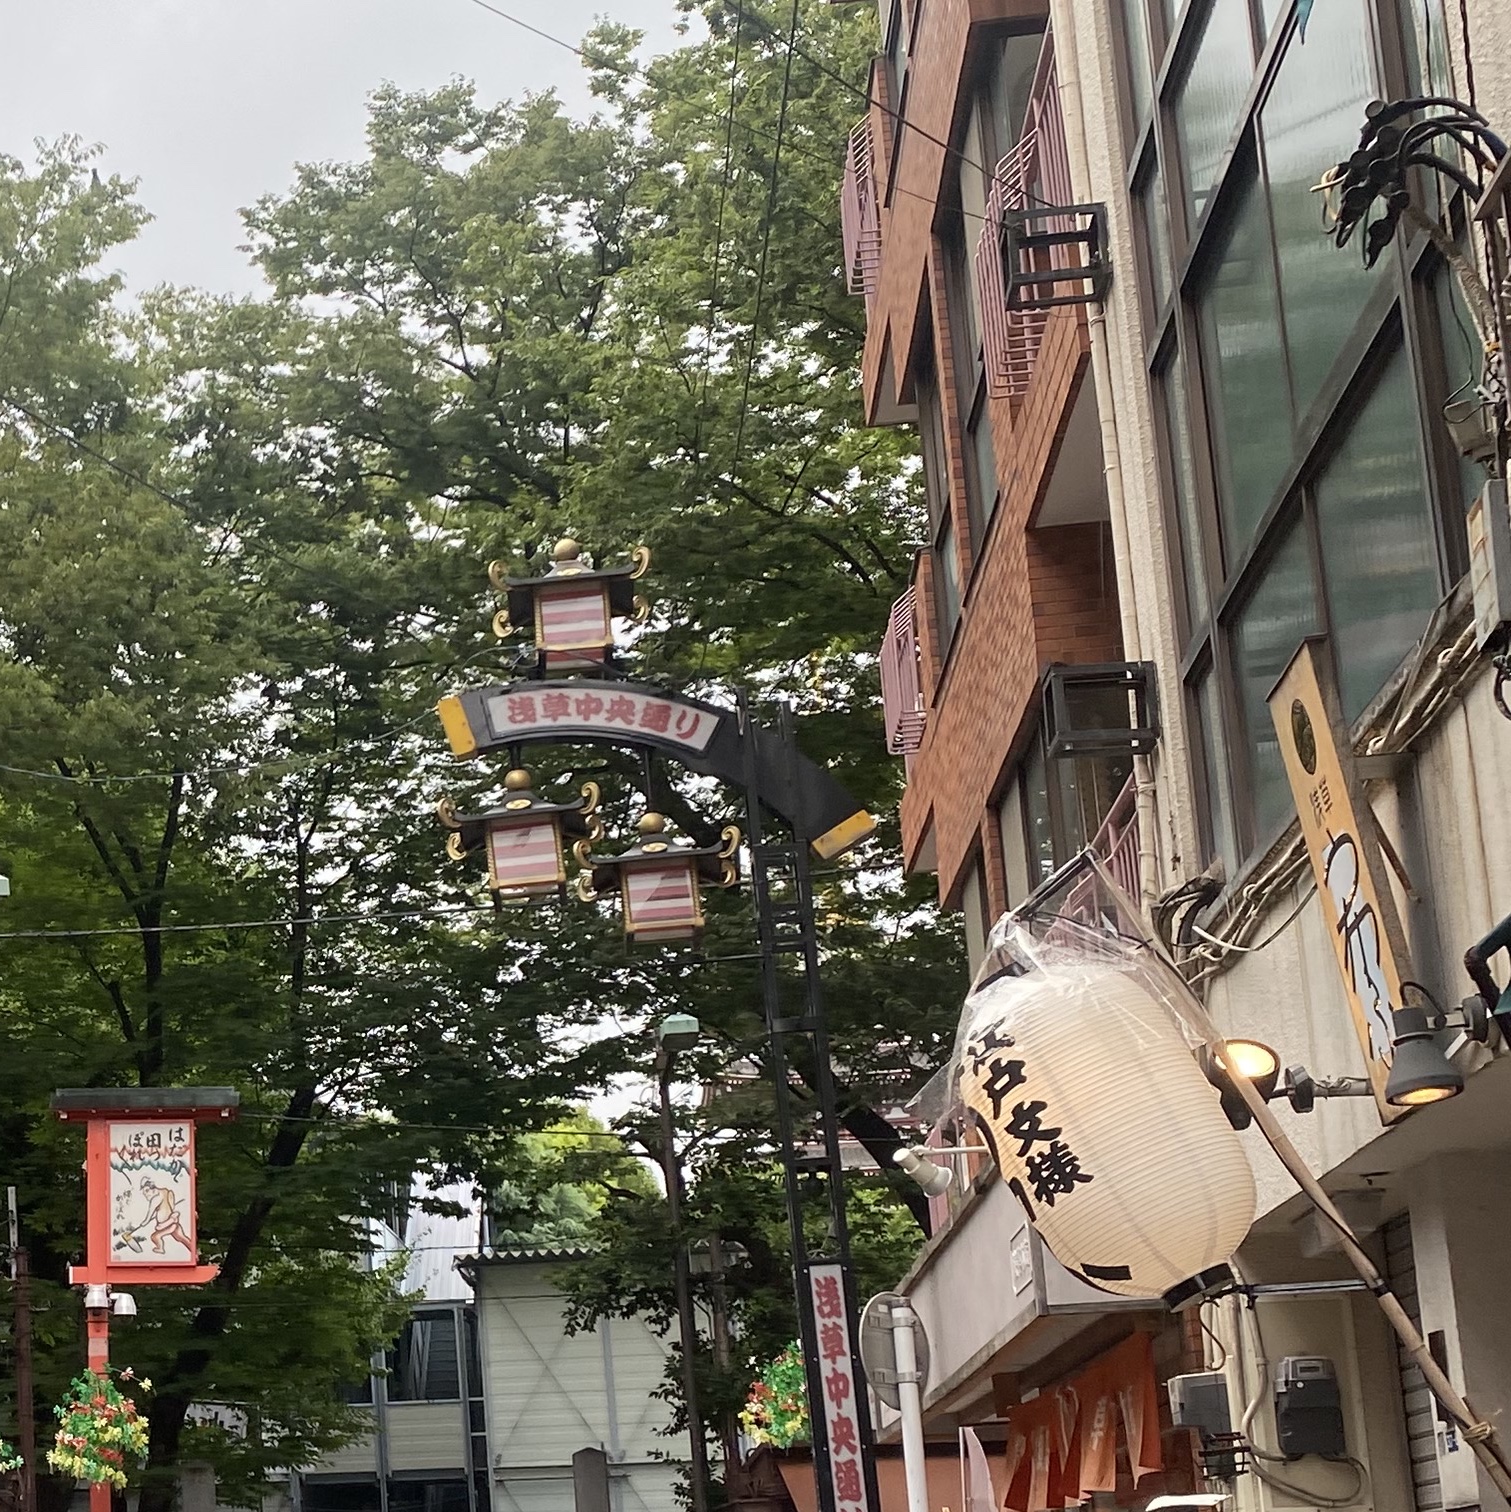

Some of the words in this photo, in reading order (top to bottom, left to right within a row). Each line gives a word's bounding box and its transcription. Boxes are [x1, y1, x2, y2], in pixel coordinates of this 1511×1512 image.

[507, 693, 701, 739] 浅草中央通り
[967, 1016, 1095, 1208] 江戸文様
